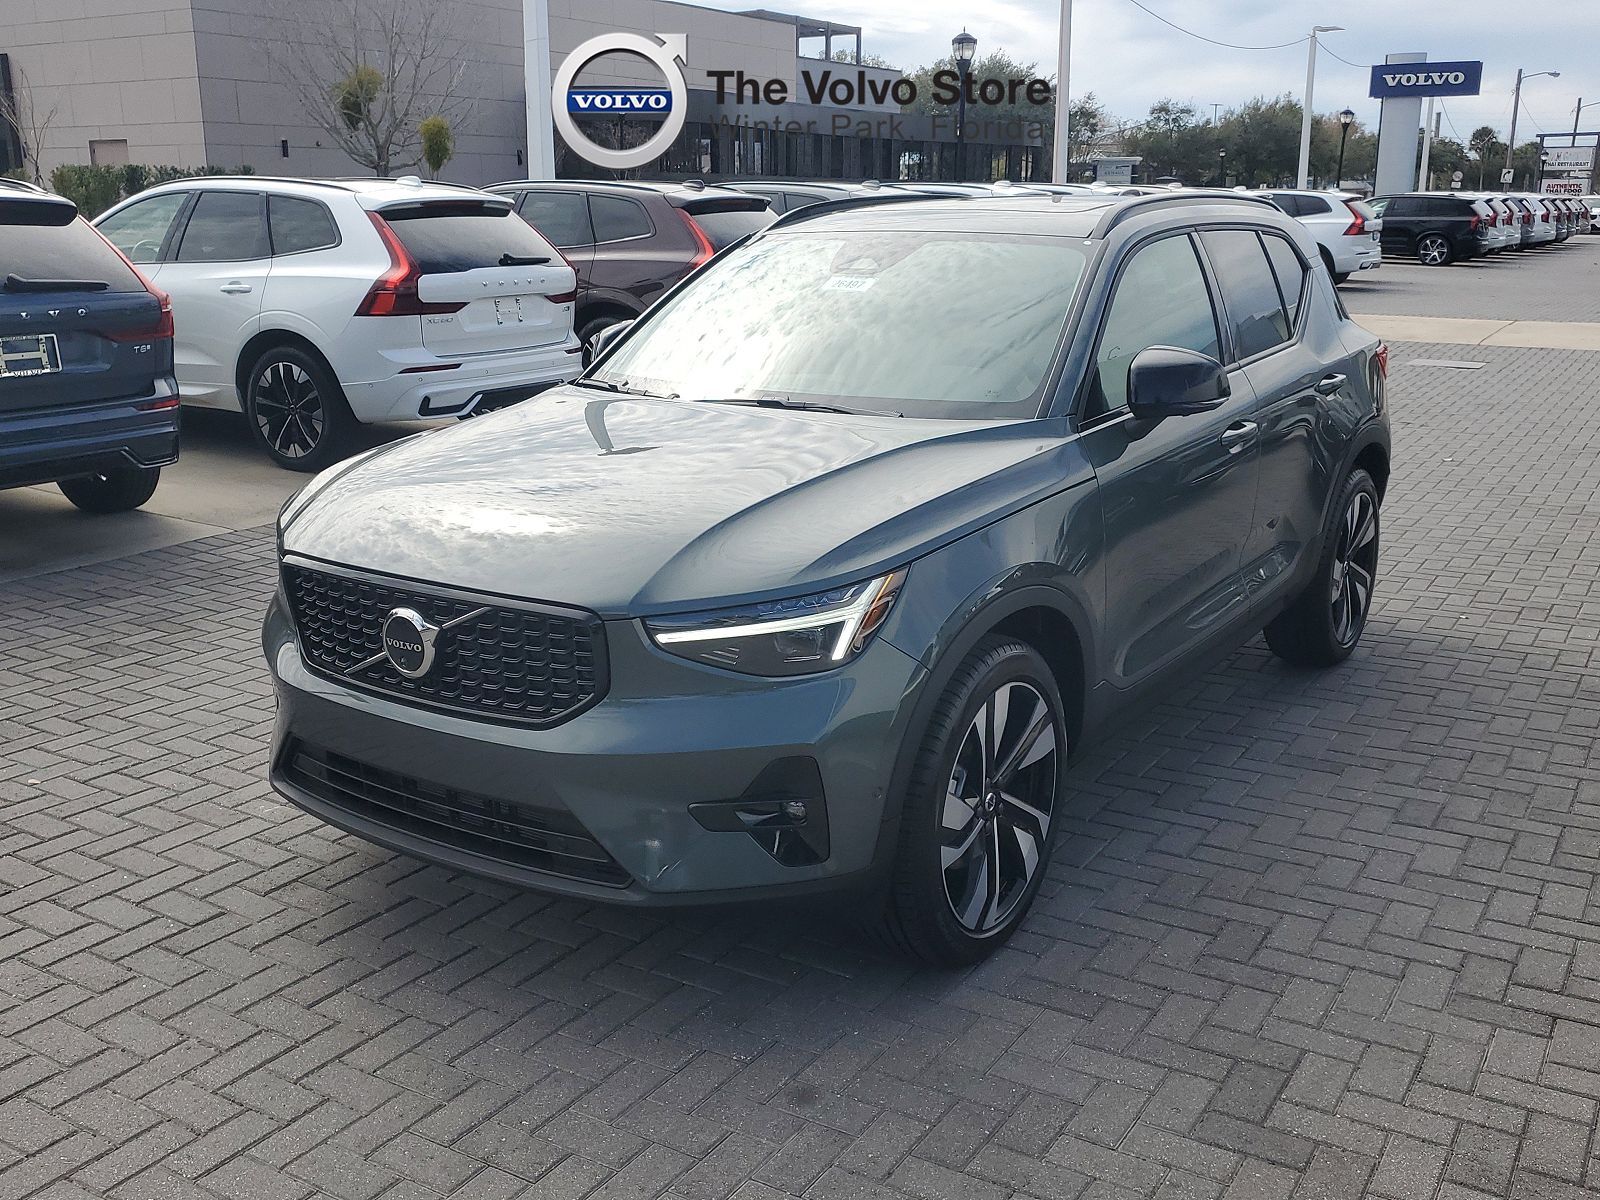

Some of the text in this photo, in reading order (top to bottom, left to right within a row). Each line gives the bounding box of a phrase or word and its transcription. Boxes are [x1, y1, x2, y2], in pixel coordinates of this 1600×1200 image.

[1383, 72, 1465, 87] VOLVO
[482, 279, 546, 288] VOLVO
[427, 317, 454, 325] XC60
[386, 637, 422, 652] VOLVO
